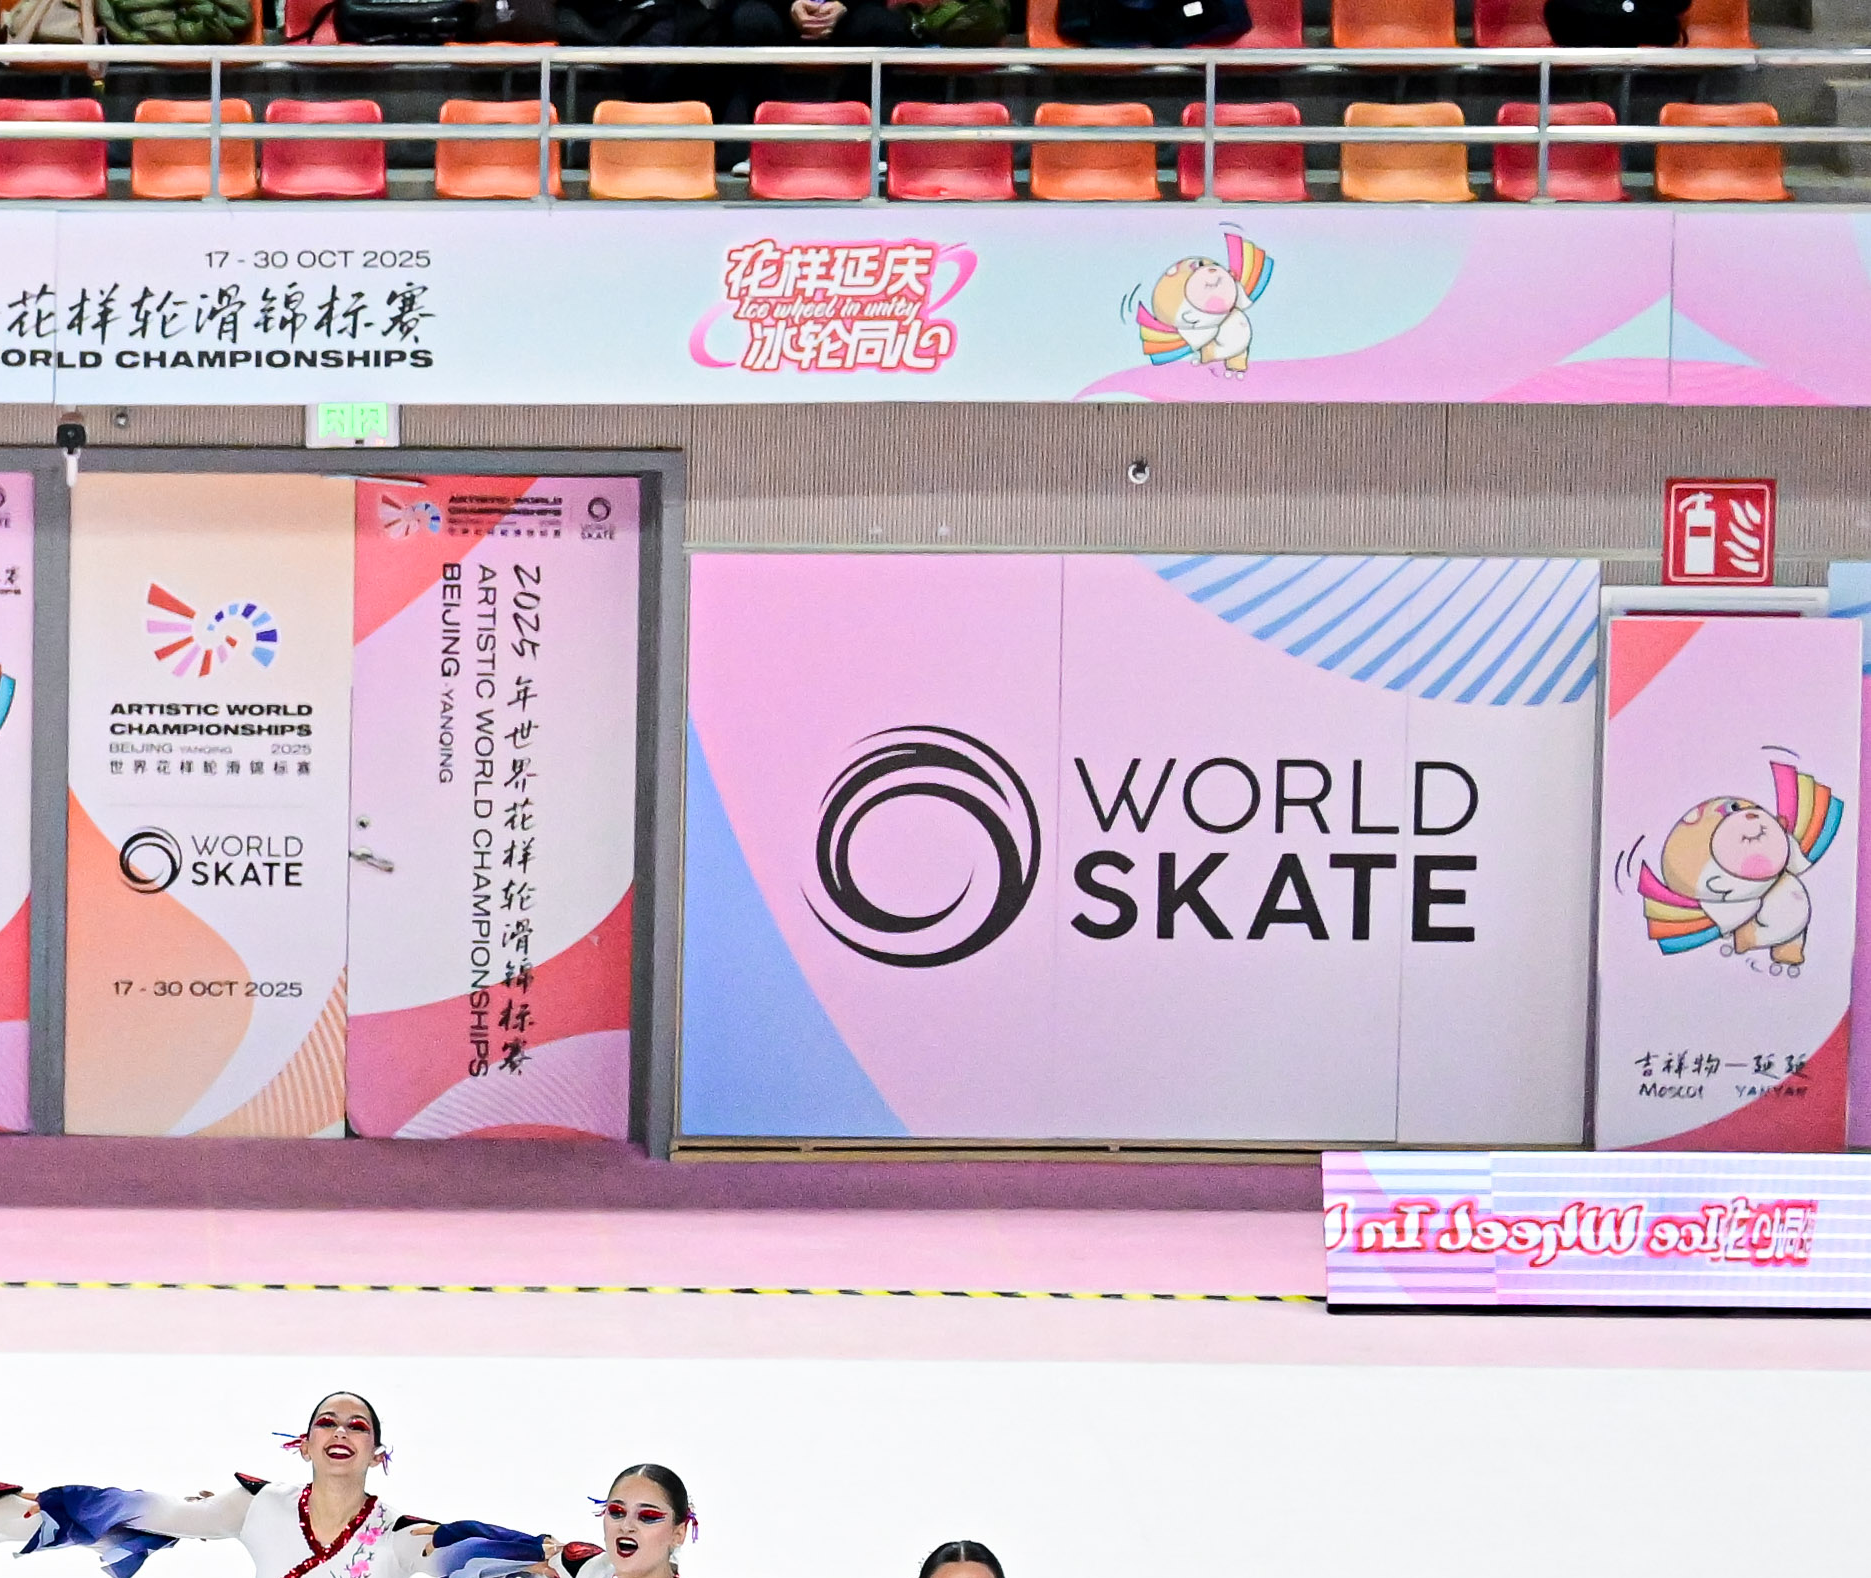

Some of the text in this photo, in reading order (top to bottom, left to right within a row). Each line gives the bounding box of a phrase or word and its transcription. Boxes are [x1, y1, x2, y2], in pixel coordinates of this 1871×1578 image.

[204, 249, 229, 268] 17
[253, 249, 288, 268] 30
[296, 249, 355, 268] OCT
[362, 249, 432, 269] 2025
[726, 238, 933, 300] 花样延庆
[741, 320, 950, 371] 冰轮同心
[115, 349, 434, 369] CHAMPIONSHIPS
[440, 562, 462, 678] BEIJING
[110, 702, 313, 717] ARTISTIC WORLD
[109, 722, 313, 737] CHAMPIONSHIPS
[109, 742, 173, 754] BEIJING
[270, 743, 312, 755] 2025
[1073, 756, 1479, 837] WORLD
[468, 564, 497, 1078] ARTISTIC WORLD CHAMPIONSHIPS
[191, 835, 304, 858] WORLD
[191, 860, 303, 887] SKATE
[1070, 850, 1478, 943] SKATE
[113, 980, 133, 996] 17
[154, 980, 184, 997] 30
[189, 980, 239, 997] OCT
[244, 981, 304, 998] 2025
